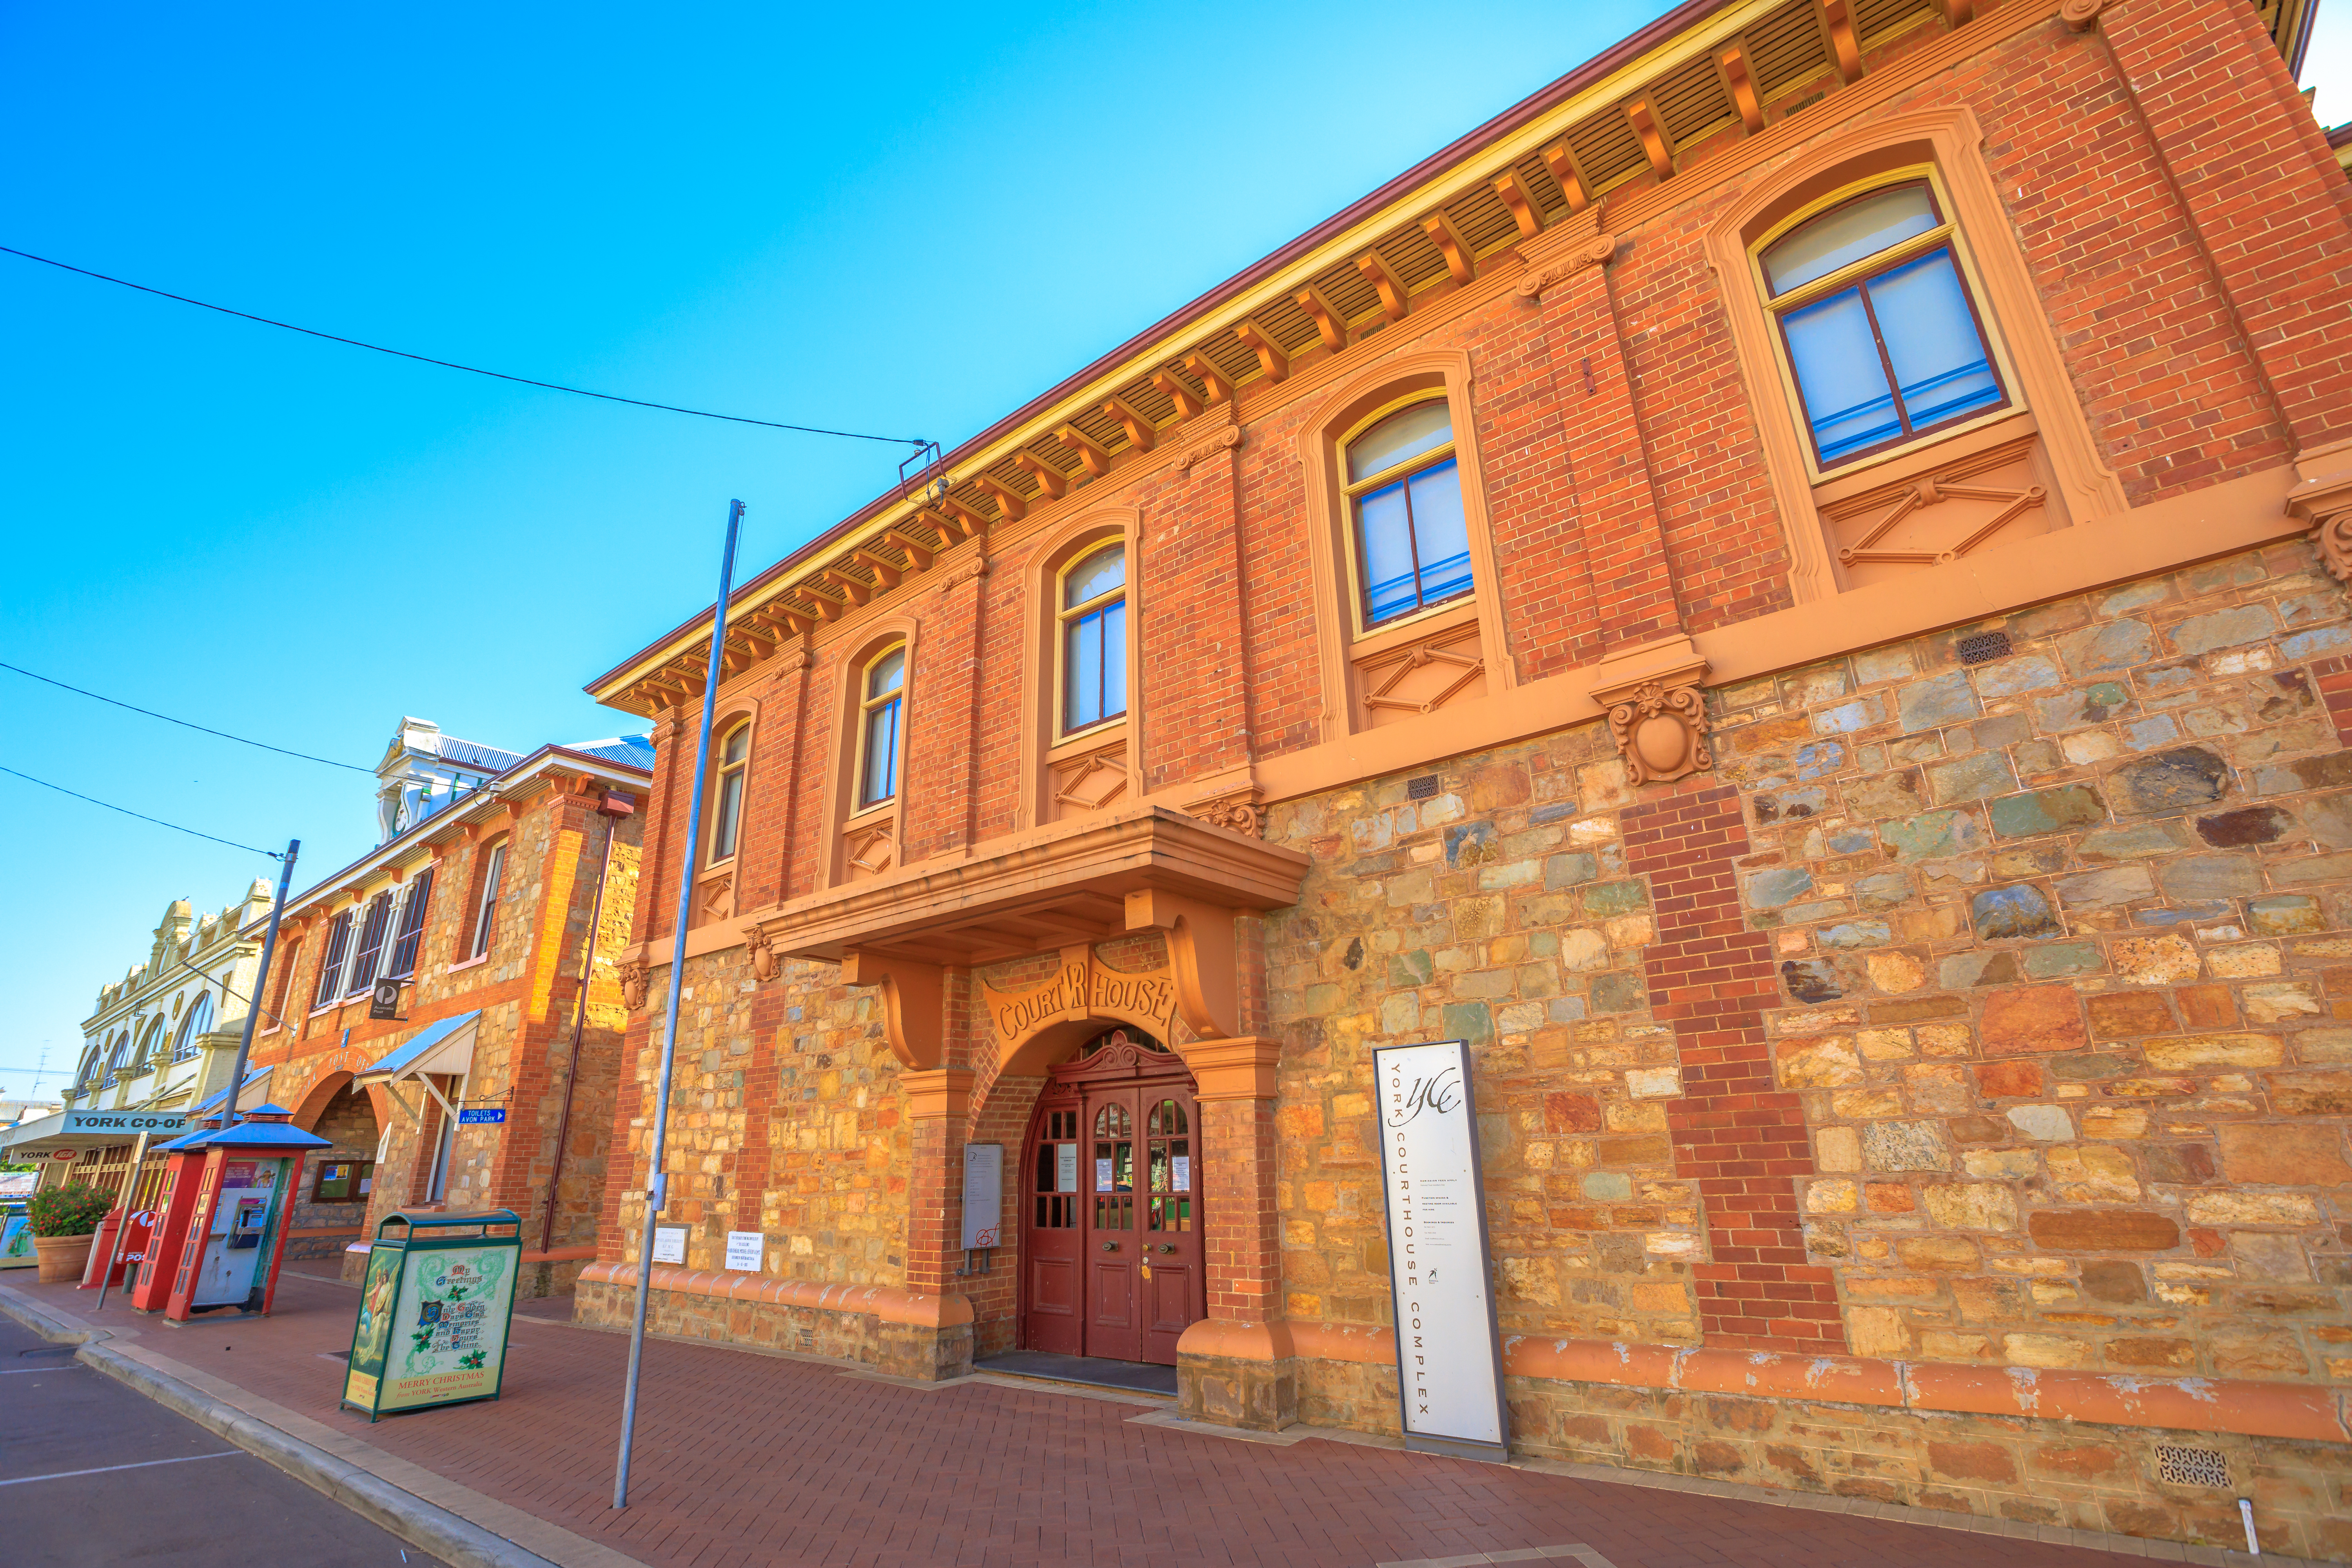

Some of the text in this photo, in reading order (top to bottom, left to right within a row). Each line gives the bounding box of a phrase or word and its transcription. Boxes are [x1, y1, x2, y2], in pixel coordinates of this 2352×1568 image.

[999, 972, 1174, 1040] COURT HOUSE
[328, 1052, 349, 1068] POST
[74, 1117, 186, 1129] YORK CO-OP
[1392, 1063, 1428, 1414] YORK COURTHOUSE COMPLEX
[451, 1265, 470, 1276] My
[436, 1275, 483, 1286] Greetings
[457, 1302, 485, 1312] Golden
[438, 1319, 479, 1328] Memories
[398, 1371, 485, 1390] MERRY CHRISTMAS
[394, 1392, 410, 1401] from
[457, 1381, 483, 1390] Australia
